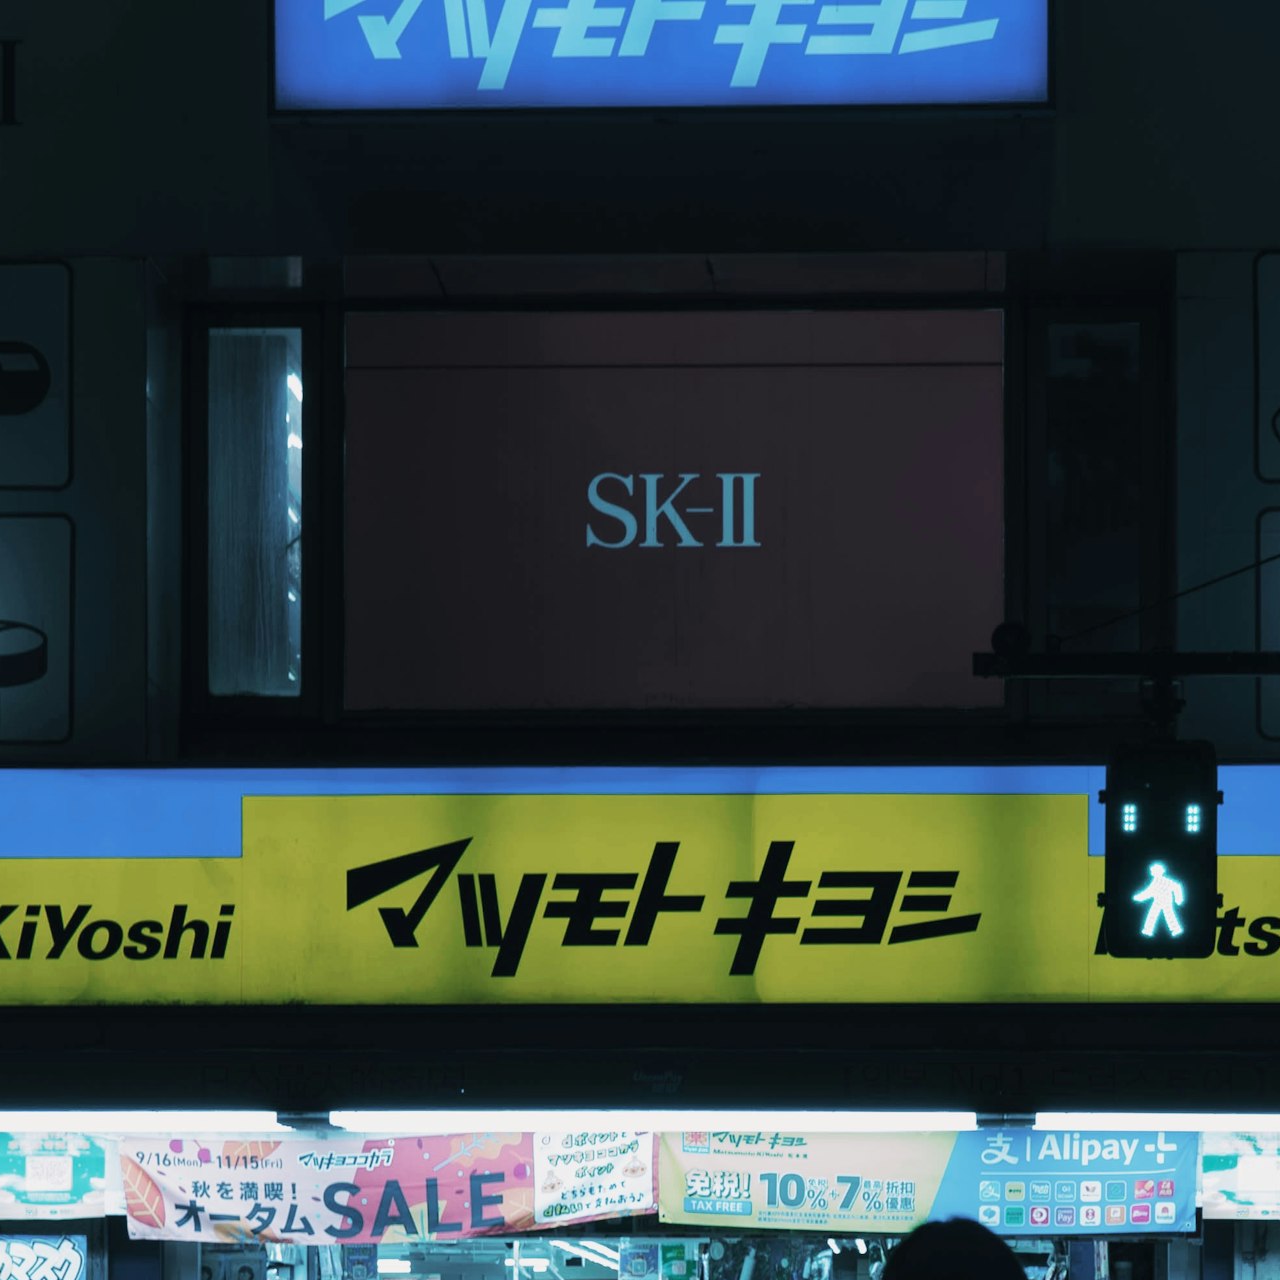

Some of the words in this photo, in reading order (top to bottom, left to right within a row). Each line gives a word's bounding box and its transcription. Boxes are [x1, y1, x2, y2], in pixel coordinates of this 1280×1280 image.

[586, 472, 762, 549] SK-II
[346, 837, 982, 977] マツモトキヨシ
[322, 1171, 508, 1239] SALE
[692, 1201, 713, 1213] TAX
[715, 1202, 743, 1214] FREE
